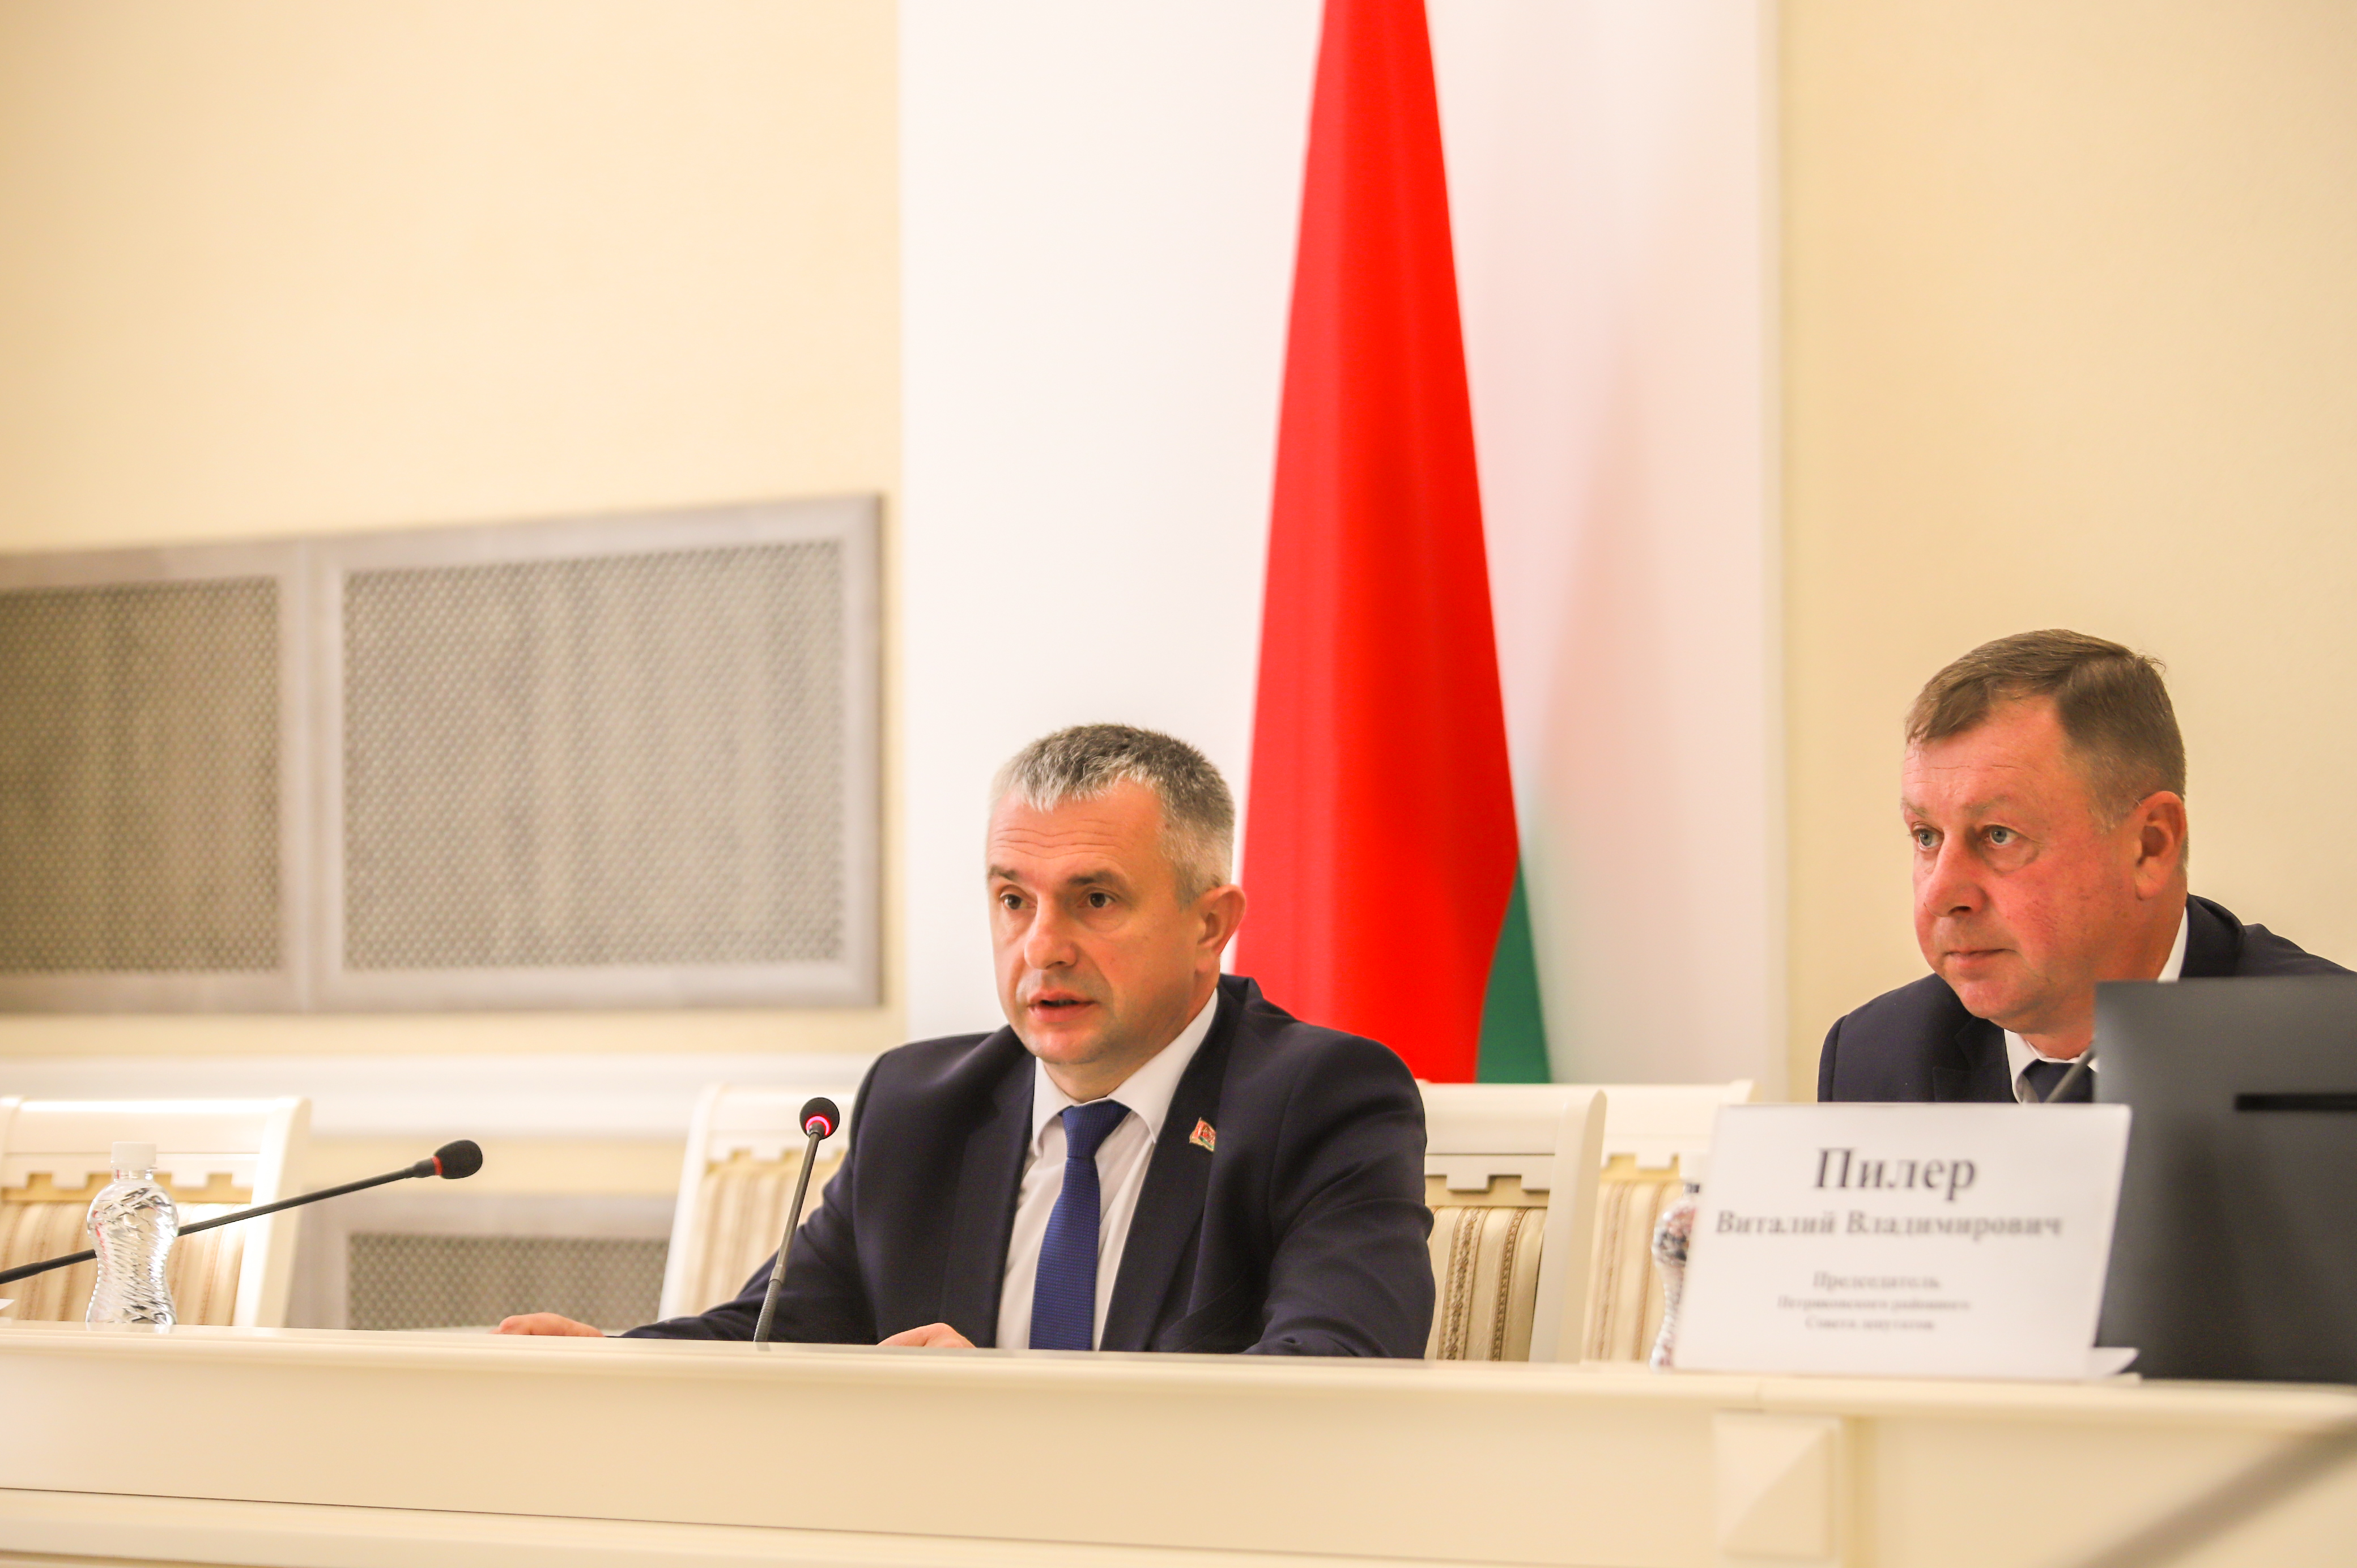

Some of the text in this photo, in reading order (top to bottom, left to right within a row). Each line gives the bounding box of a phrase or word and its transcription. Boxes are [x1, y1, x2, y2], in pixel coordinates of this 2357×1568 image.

[1814, 1148, 1976, 1200] Пилер
[1715, 1209, 2064, 1242] Виталий Владимирович
